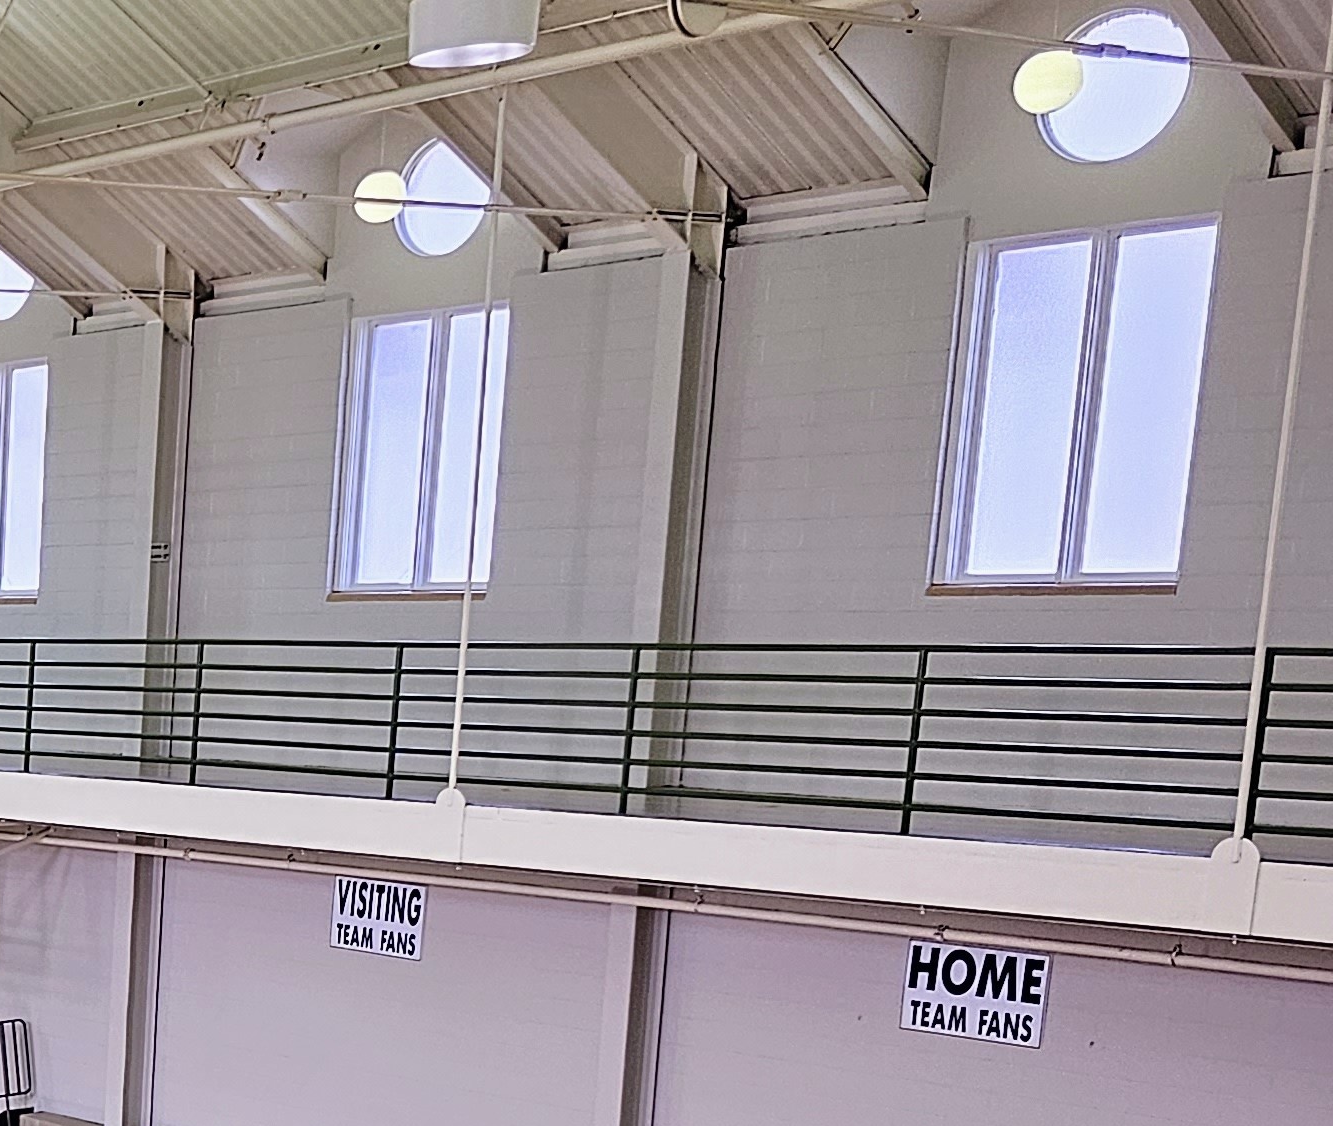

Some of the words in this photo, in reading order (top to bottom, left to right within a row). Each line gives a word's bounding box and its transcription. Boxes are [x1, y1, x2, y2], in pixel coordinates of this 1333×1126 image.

[338, 879, 422, 926] VISITING
[336, 922, 374, 949] TEAM
[380, 929, 416, 956] FANS
[908, 945, 1046, 1005] HOME
[910, 1000, 967, 1033] TEAM
[978, 1009, 1034, 1043] FANS
